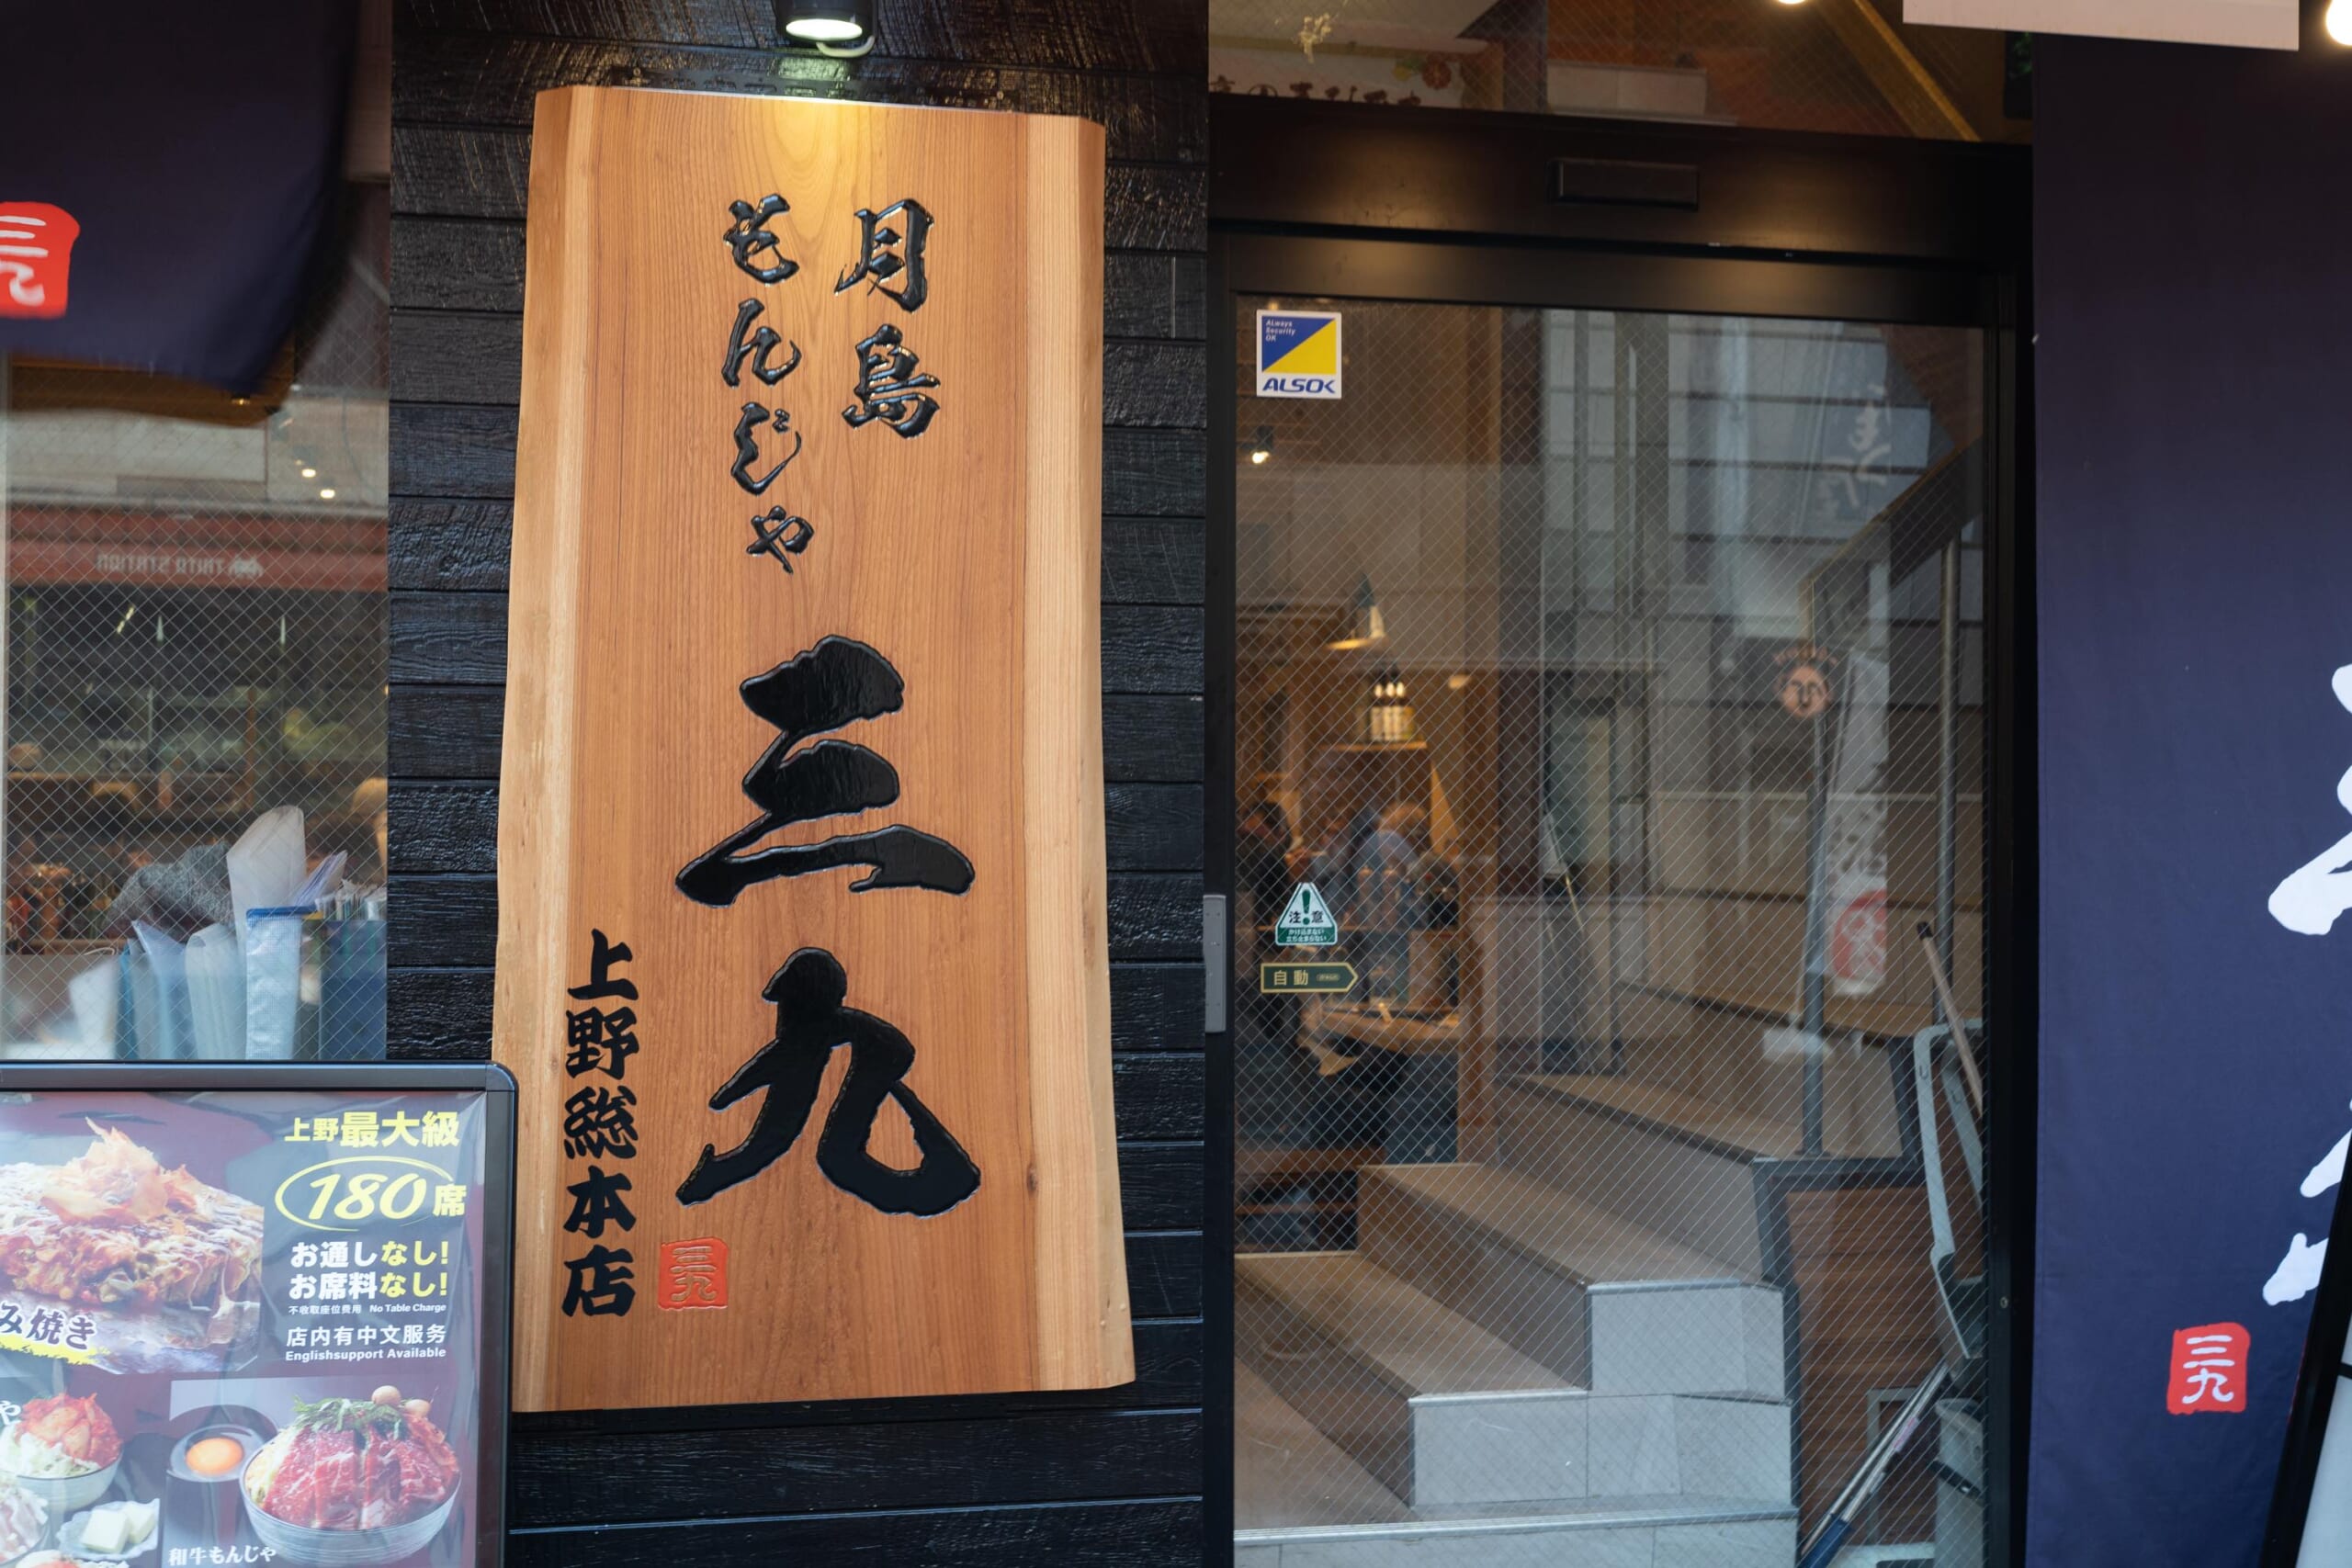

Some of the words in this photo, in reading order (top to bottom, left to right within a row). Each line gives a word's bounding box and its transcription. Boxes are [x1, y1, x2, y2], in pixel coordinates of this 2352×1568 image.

[834, 198, 941, 439] 月島
[1266, 327, 1296, 336] Security
[1262, 378, 1336, 394] ALSOK
[674, 634, 981, 1218] 三九
[1289, 910, 1324, 923] 注意
[1273, 970, 1308, 986] 自動
[284, 1111, 459, 1147] 上野最大級
[561, 928, 639, 1317] 上野総本店
[290, 1241, 448, 1268] お通しなし!
[288, 1271, 447, 1300] お席料なし!
[669, 1247, 717, 1303] 三九
[369, 1304, 383, 1313] No
[385, 1303, 411, 1313] Table
[413, 1303, 447, 1314] Charge
[287, 1324, 447, 1348] 店内有中文服务
[286, 1349, 383, 1363] Englishsupport
[387, 1347, 447, 1359] Available
[2181, 1334, 2235, 1404] 三九
